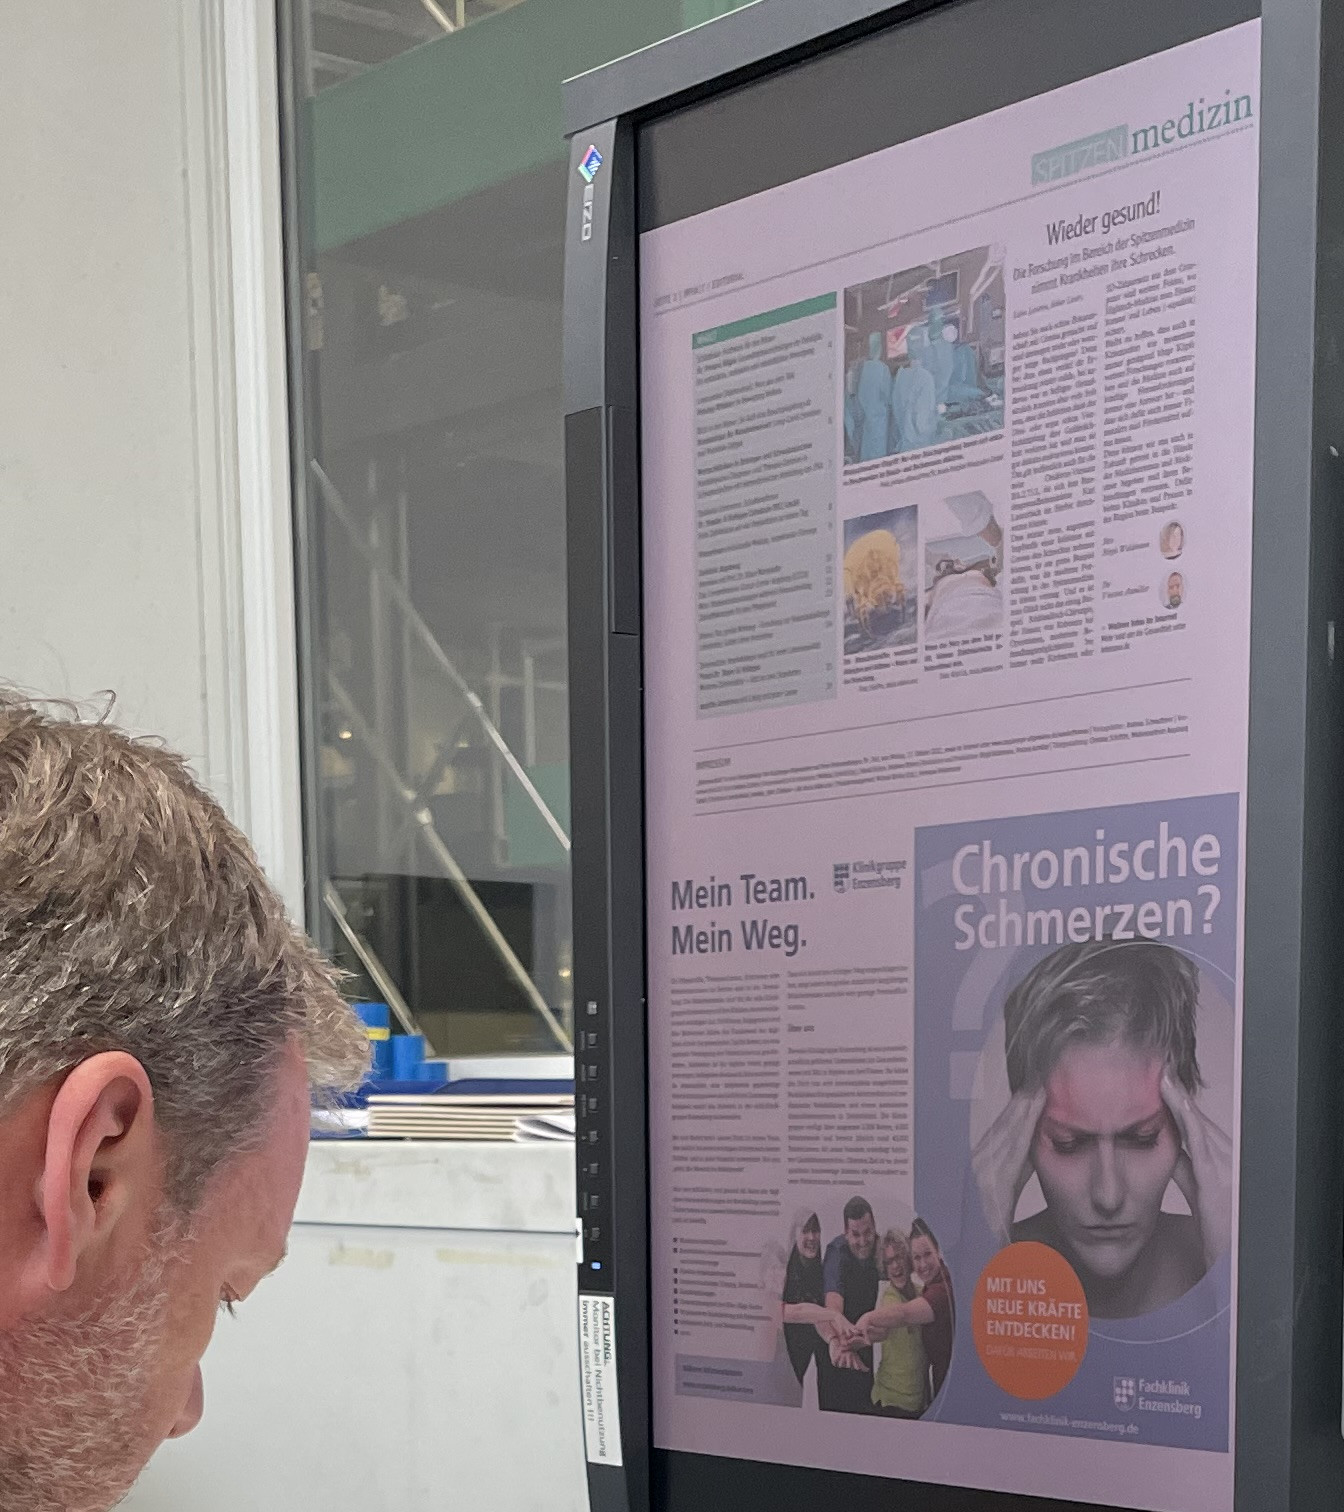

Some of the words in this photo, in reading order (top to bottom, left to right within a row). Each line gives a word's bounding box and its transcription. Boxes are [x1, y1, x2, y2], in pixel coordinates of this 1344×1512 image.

[1047, 214, 1098, 245] Wieder
[1102, 190, 1161, 235] gesund!
[953, 822, 1220, 896] Chronische
[672, 876, 732, 910] Mein
[741, 874, 815, 904] Team.
[954, 886, 1219, 950] Schmerzen?
[672, 922, 732, 955] Mein
[741, 919, 807, 957] Weg.
[987, 1278, 1012, 1293] MIT
[1017, 1280, 1046, 1295] UNS
[987, 1299, 1023, 1315] NEUE
[1028, 1297, 1082, 1319] KRÄFTE
[987, 1320, 1076, 1341] ENTDECKEN!
[1139, 1378, 1191, 1396] Fachklinik
[1139, 1397, 1202, 1419] Enzensberg
